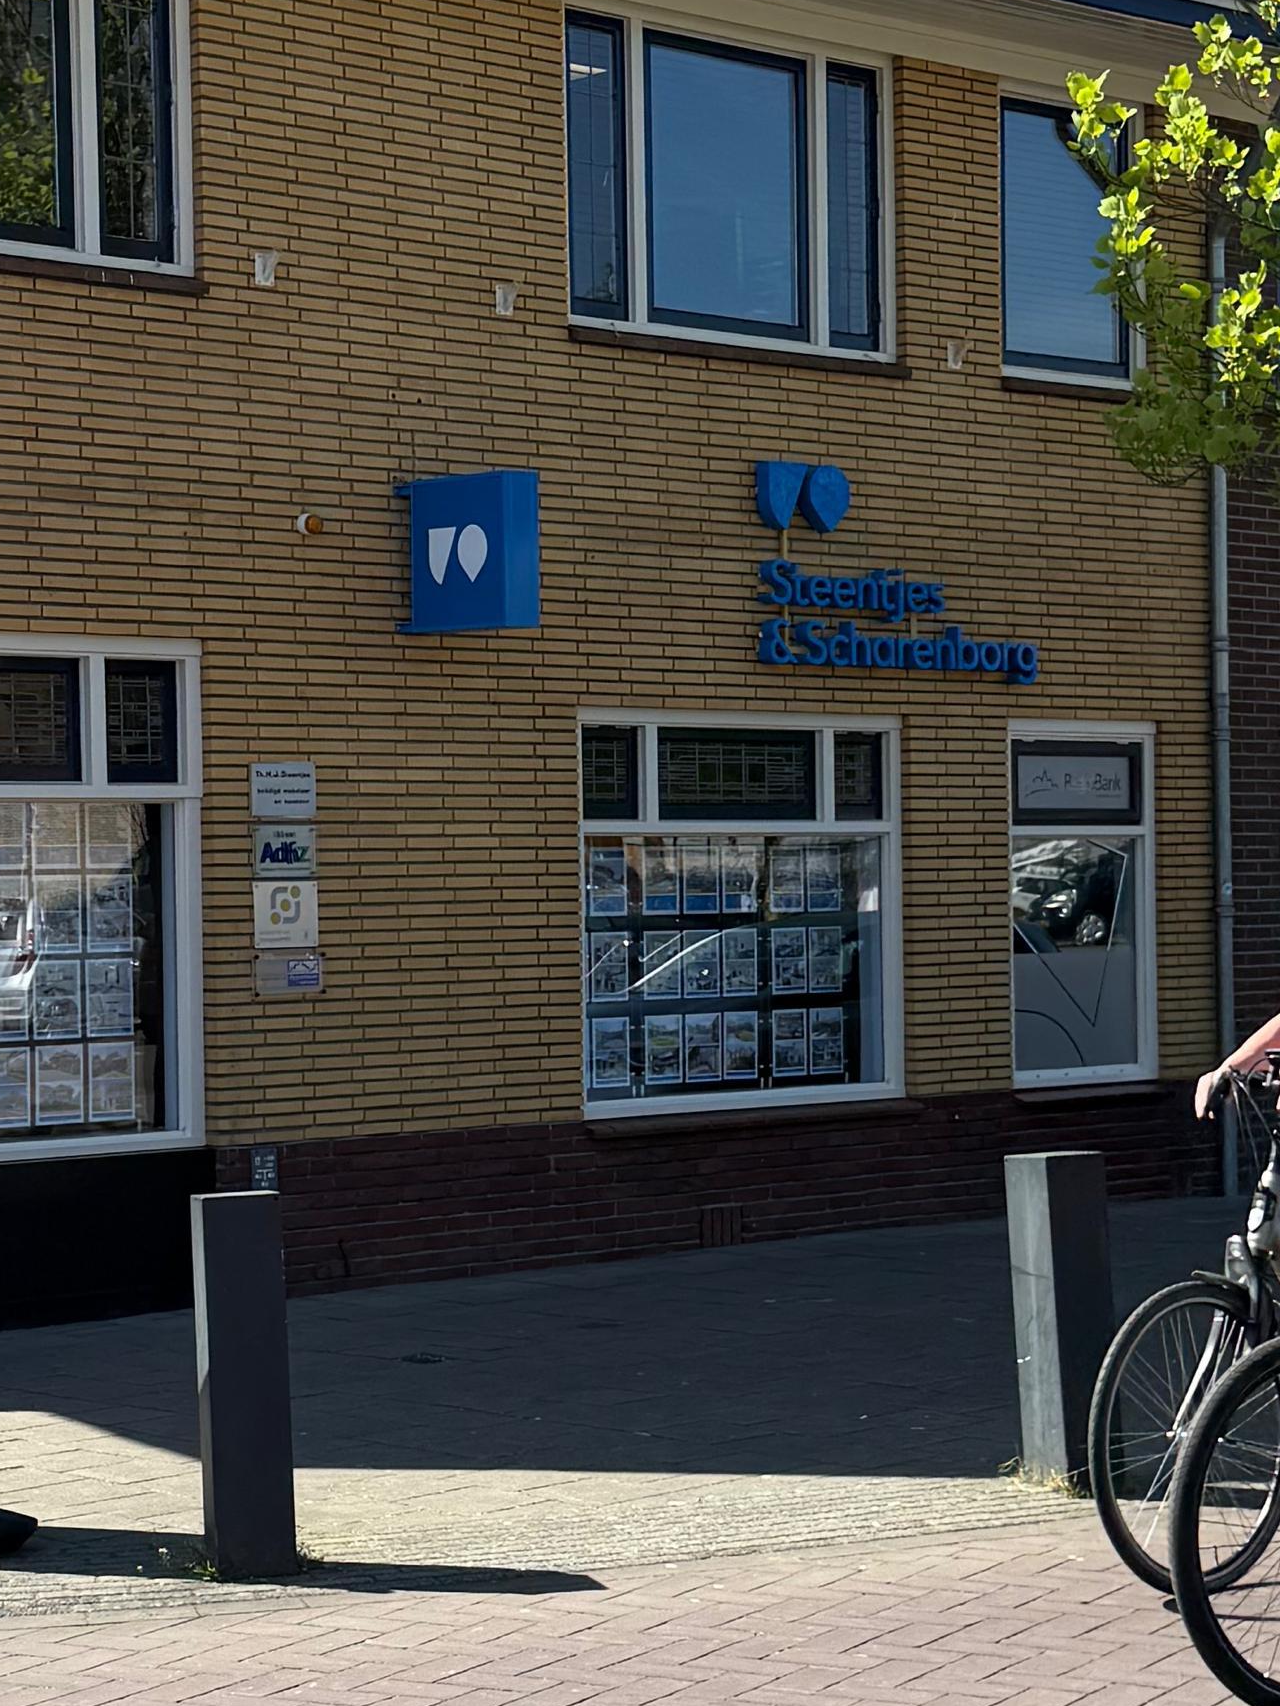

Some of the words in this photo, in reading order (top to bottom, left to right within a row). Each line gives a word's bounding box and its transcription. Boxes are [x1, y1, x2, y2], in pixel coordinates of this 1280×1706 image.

[756, 557, 946, 623] Steentjes
[758, 618, 800, 667] &
[797, 621, 1038, 683] Scharenborg
